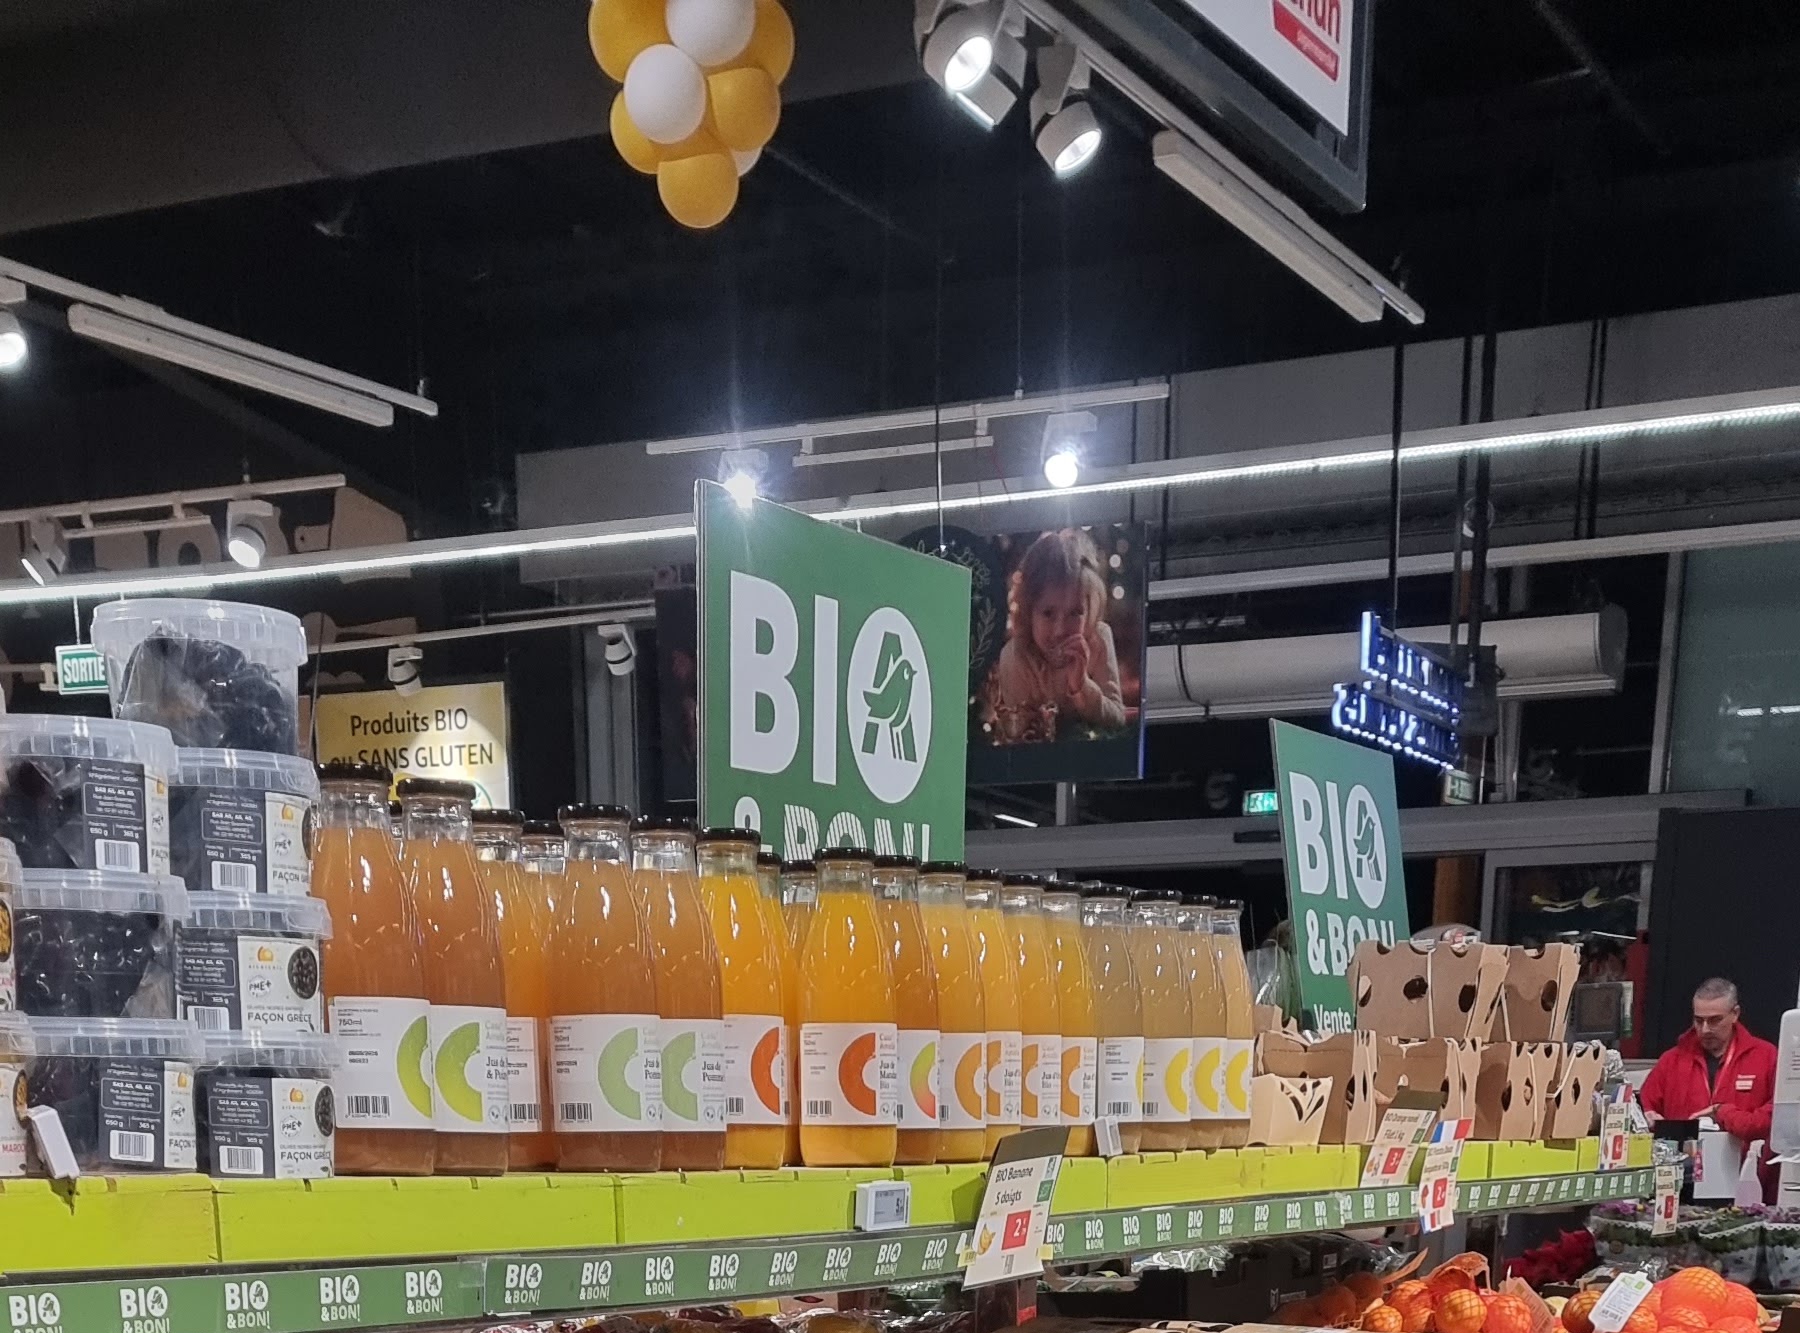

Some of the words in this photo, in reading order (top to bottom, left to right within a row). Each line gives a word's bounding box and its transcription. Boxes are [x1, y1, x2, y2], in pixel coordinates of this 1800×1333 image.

[62, 653, 105, 684] SORTIE
[730, 570, 932, 804] BIO
[351, 709, 430, 738] Produits
[434, 708, 469, 732] BIO
[357, 748, 410, 770] SANS
[414, 742, 494, 768] GLUTEN
[1289, 771, 1388, 910] BIO
[247, 1012, 284, 1024] FAÇON
[1313, 1003, 1351, 1034] Vente
[280, 1151, 312, 1163] FAÇON
[1008, 1166, 1034, 1180] Banane
[1001, 1188, 1022, 1206] doigts
[1085, 1219, 1104, 1239] BIO
[1122, 1215, 1140, 1235] BIO
[1156, 1212, 1172, 1232] BIO
[1188, 1209, 1203, 1228] BIO
[1046, 1223, 1065, 1243] BIO
[825, 1246, 852, 1269] BIO
[876, 1242, 902, 1264] BIO
[924, 1238, 948, 1259] BIO
[580, 1260, 612, 1285] BIO
[645, 1255, 675, 1281] BIO
[709, 1253, 740, 1277] BIO
[770, 1250, 798, 1273] BIO
[405, 1270, 442, 1299] BIO
[506, 1263, 543, 1288] BIO
[119, 1285, 168, 1318] BIO
[224, 1280, 269, 1311] BIO
[319, 1275, 360, 1305] BIO
[8, 1292, 61, 1327] BIO
